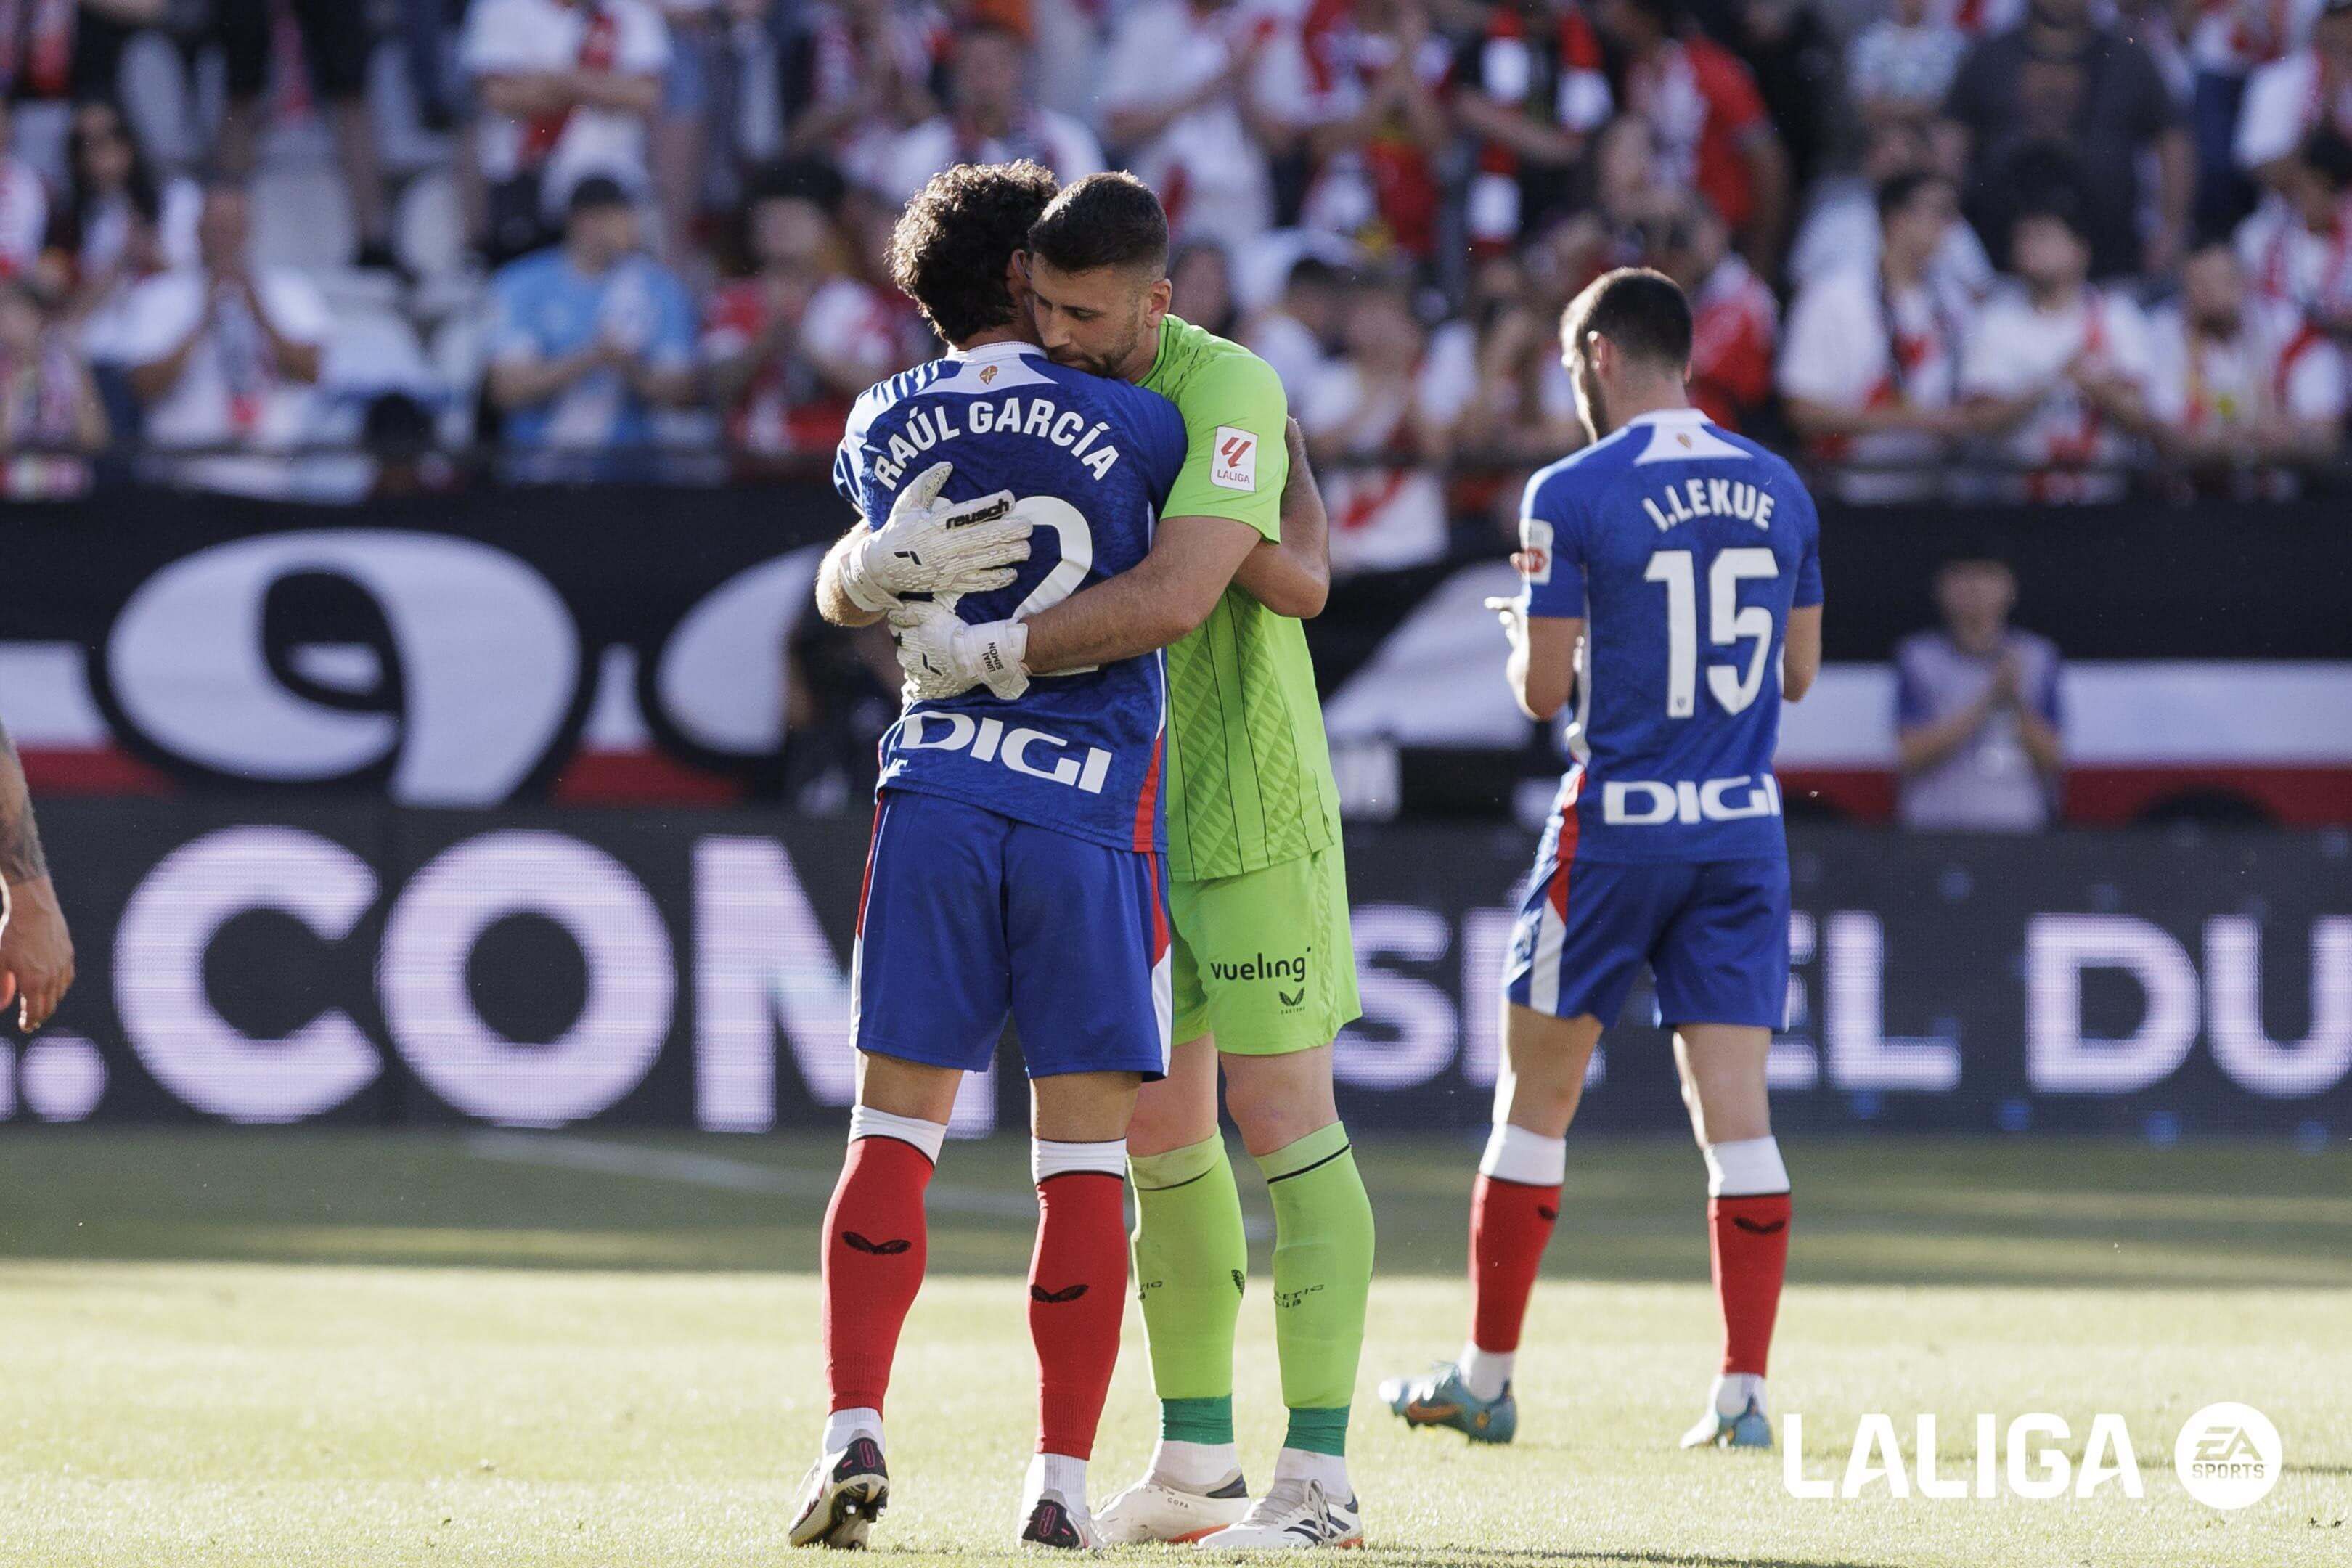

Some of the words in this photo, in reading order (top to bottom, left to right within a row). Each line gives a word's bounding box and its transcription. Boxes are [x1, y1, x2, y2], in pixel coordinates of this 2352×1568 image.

[873, 406, 960, 491] RAÚL
[968, 397, 1119, 481] GARCÍA
[1217, 470, 1250, 483] LALIGA
[946, 498, 1009, 530] reusch
[1641, 478, 1775, 532] I.LEKUE
[1643, 548, 1779, 718] 15
[900, 711, 1112, 794] DIGI
[1604, 773, 1781, 825] DIGI
[1210, 946, 1312, 982] vueling
[1167, 1497, 1189, 1508] COPA
